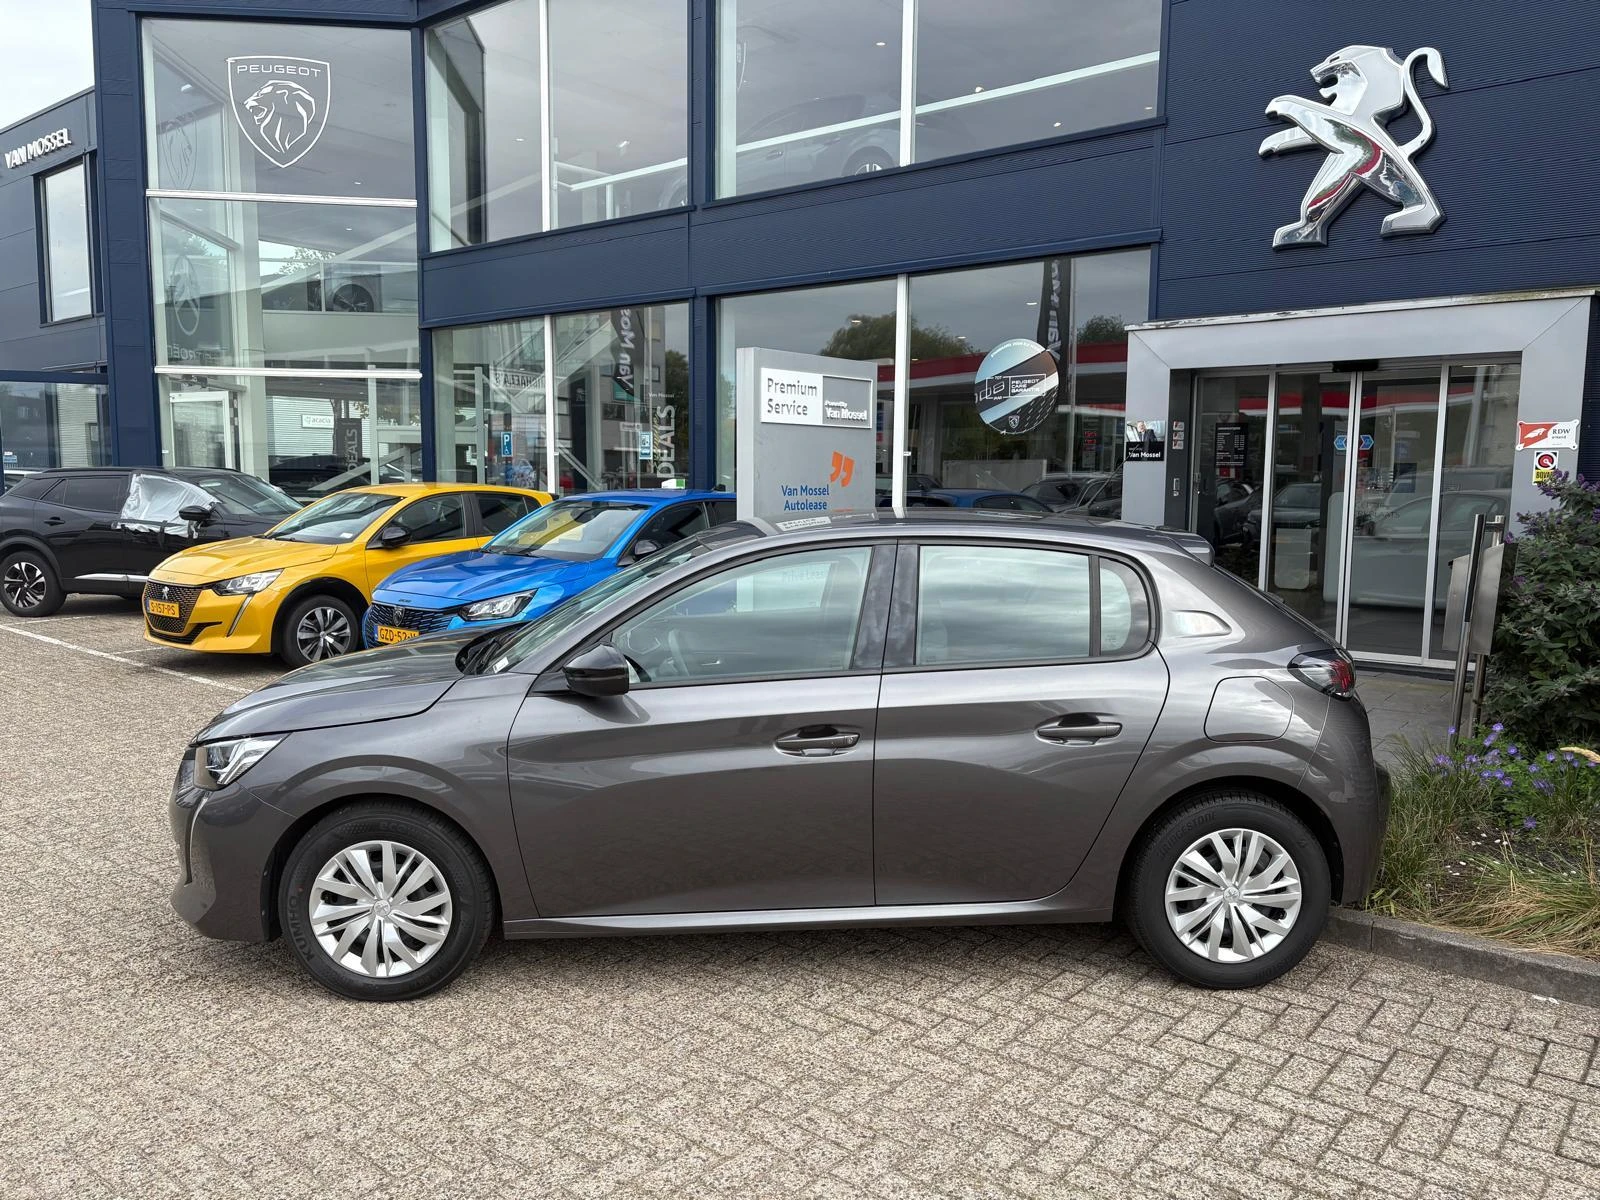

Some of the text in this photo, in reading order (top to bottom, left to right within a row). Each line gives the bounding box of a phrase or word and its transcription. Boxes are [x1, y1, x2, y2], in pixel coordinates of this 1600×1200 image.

[237, 64, 321, 77] PEUGEOT
[4, 127, 72, 169] VAN MOSSEL
[767, 377, 818, 396] Premium
[767, 398, 808, 416] Service
[826, 407, 868, 422] Van Mossel
[657, 405, 675, 478] DEALS
[781, 484, 830, 496] Van Mossel
[784, 499, 827, 511] Autolease
